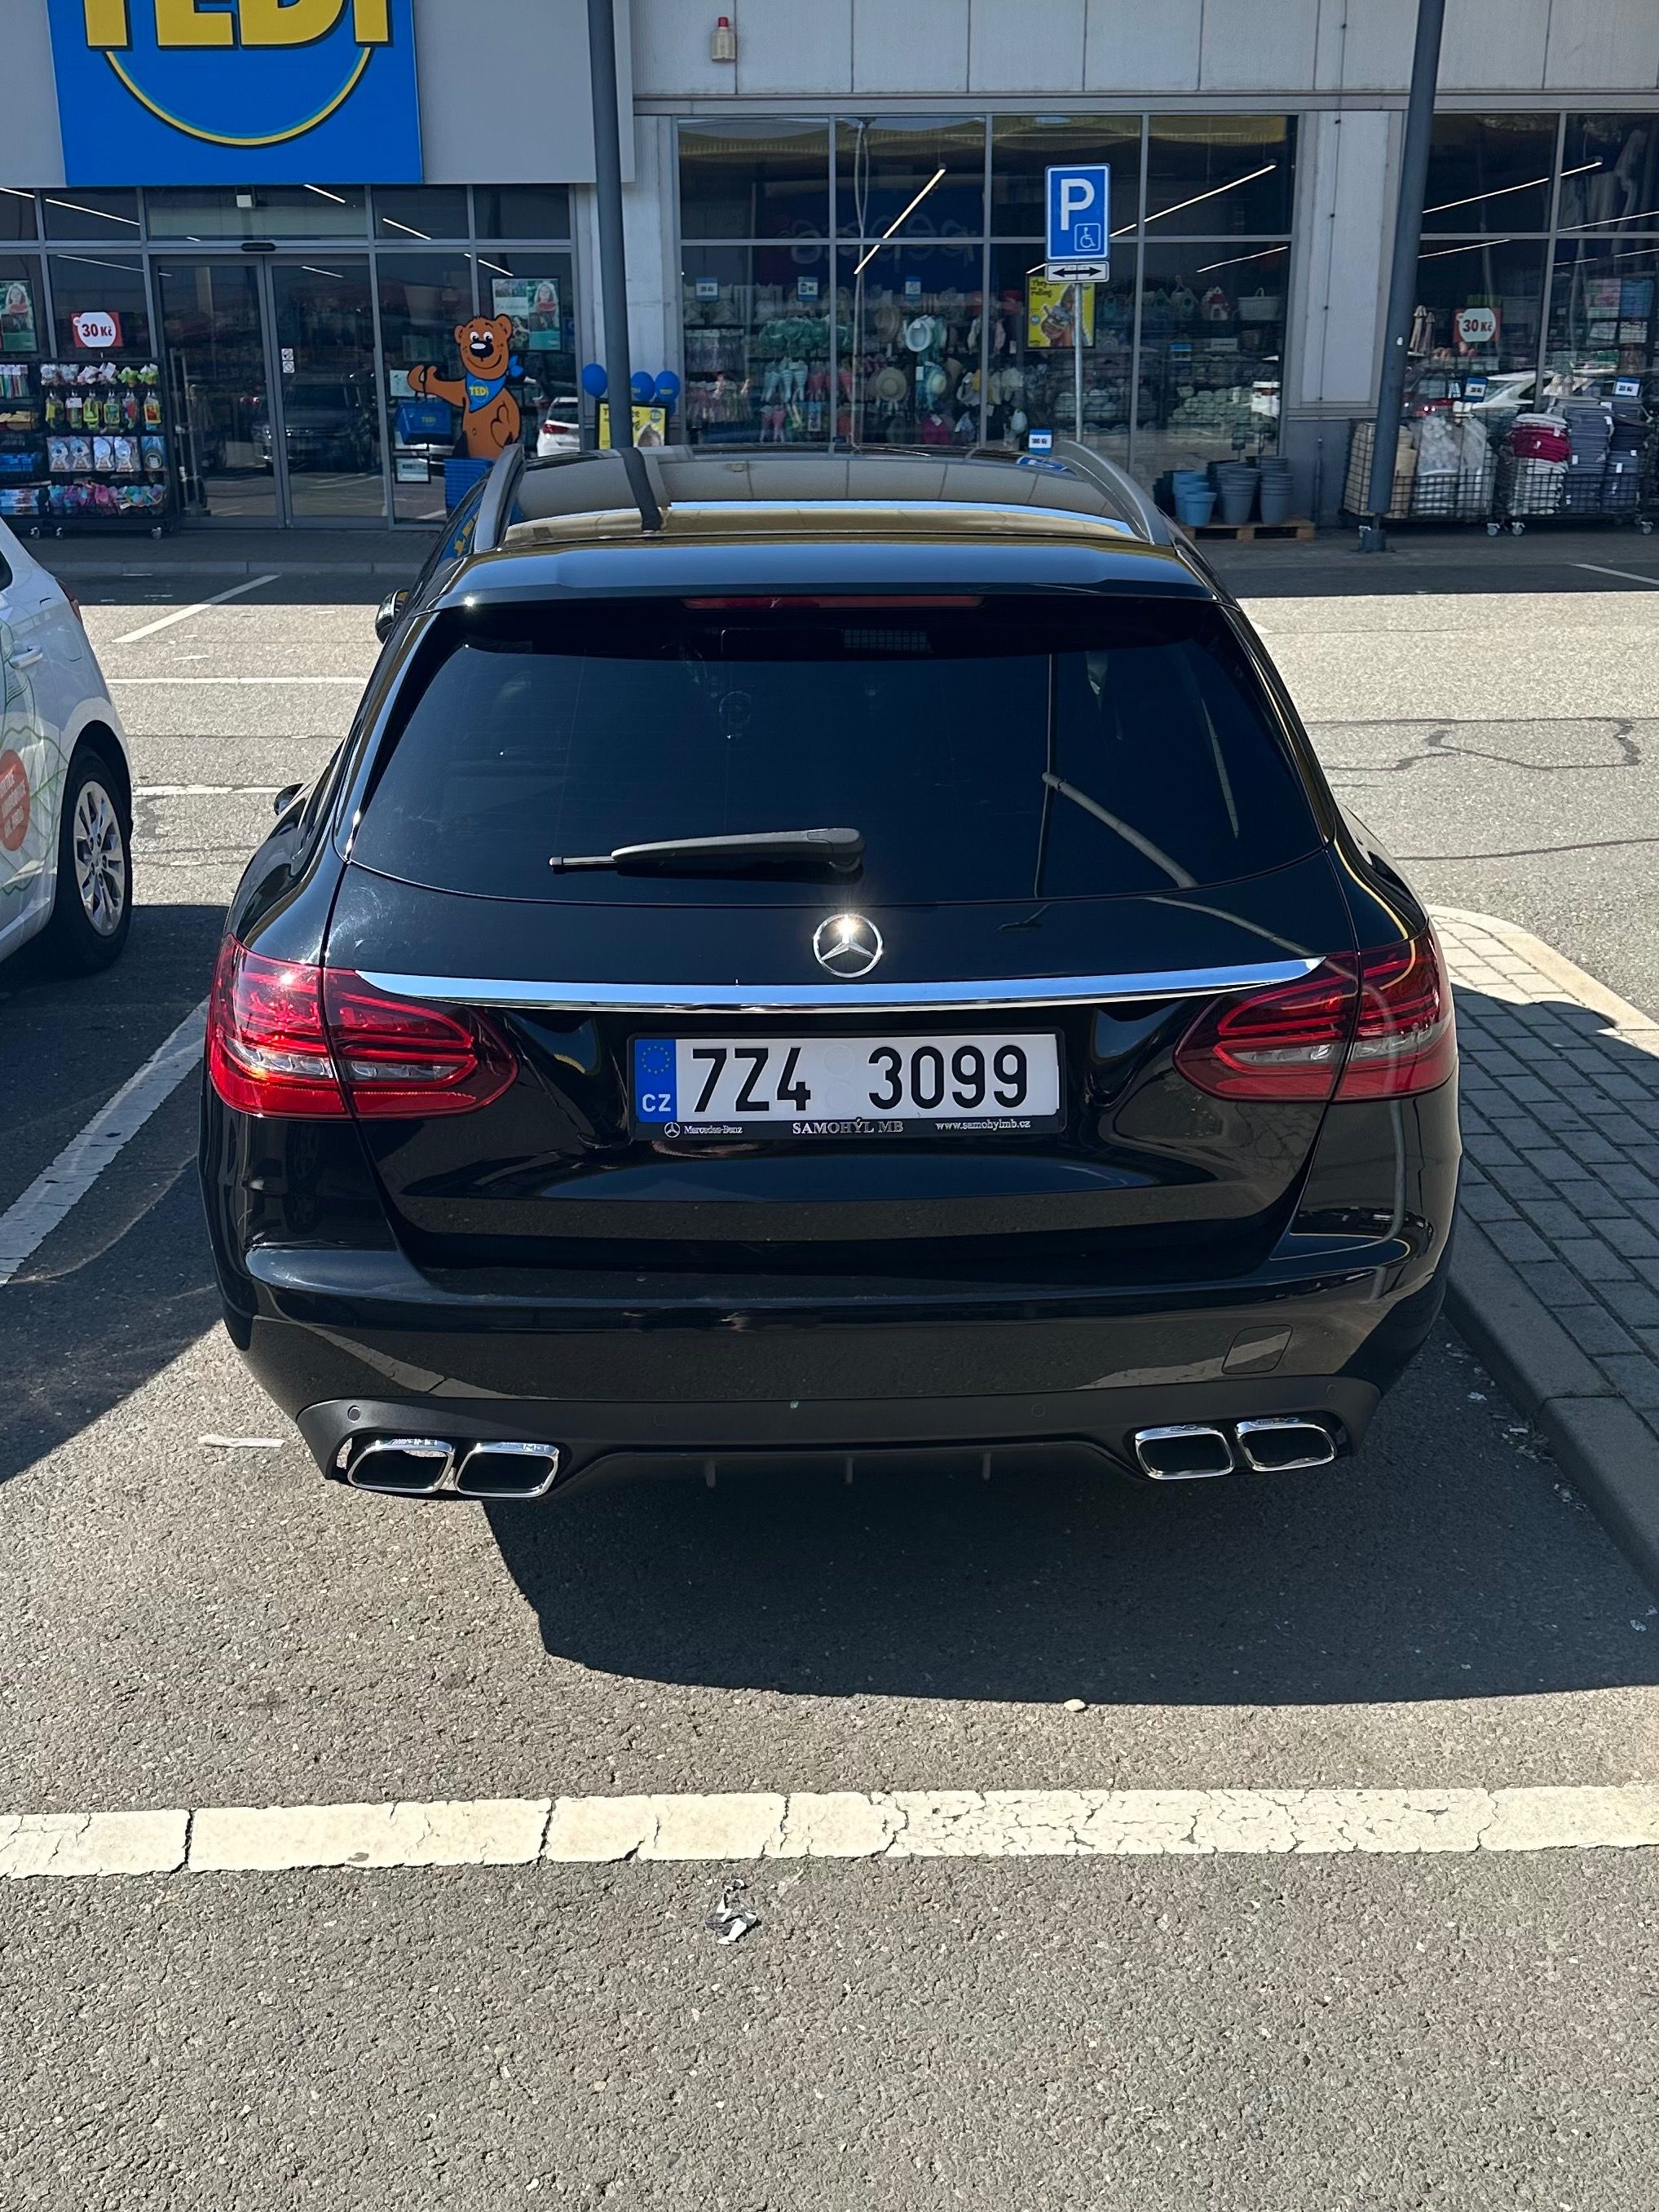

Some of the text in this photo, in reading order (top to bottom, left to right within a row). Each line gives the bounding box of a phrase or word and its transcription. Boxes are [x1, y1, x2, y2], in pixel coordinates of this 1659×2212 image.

[1061, 179, 1095, 231] P
[82, 324, 99, 337] 30
[1463, 319, 1493, 333] 30 Kč
[692, 1044, 1027, 1113] 7Z4 3099
[642, 1093, 671, 1112] CZ
[684, 1125, 743, 1134] Mercedes-Benz
[792, 1116, 904, 1134] SAMOHÝL MB
[935, 1119, 1031, 1131] www.samohylmb.cz
